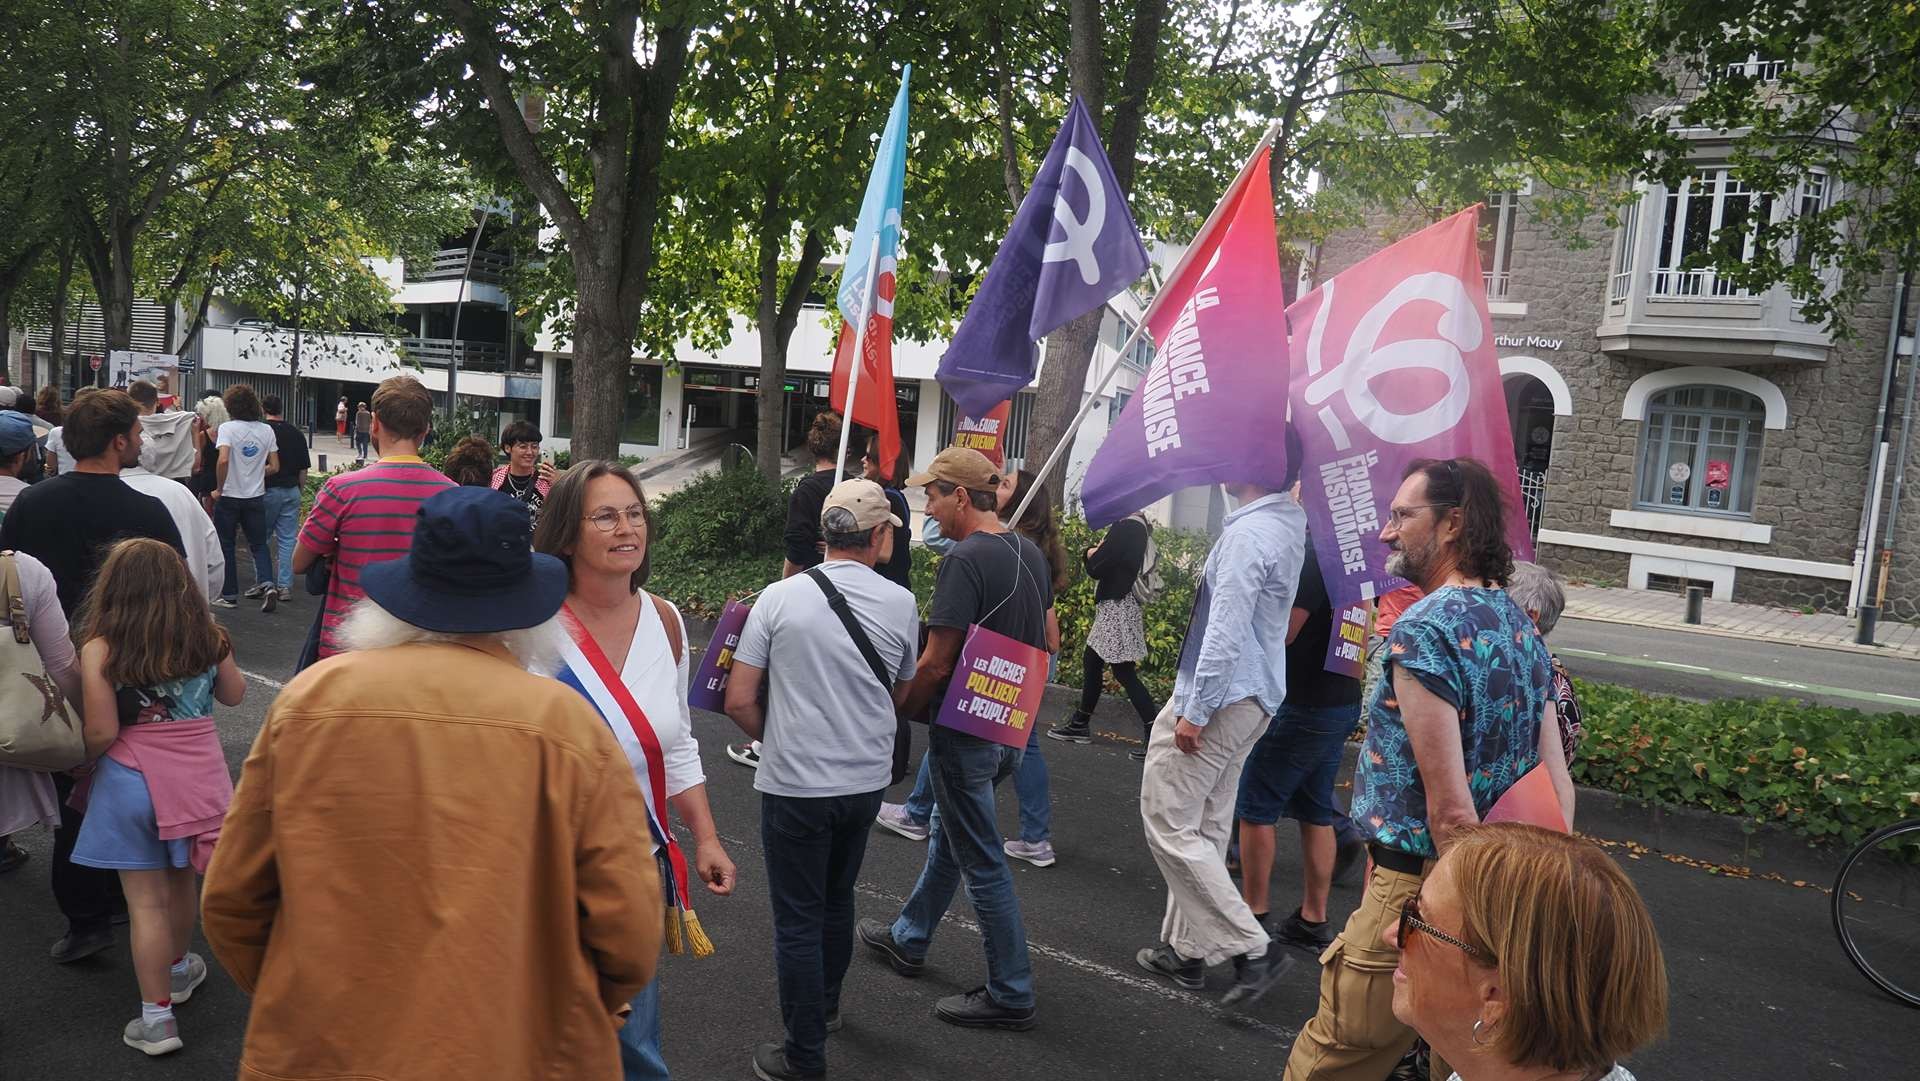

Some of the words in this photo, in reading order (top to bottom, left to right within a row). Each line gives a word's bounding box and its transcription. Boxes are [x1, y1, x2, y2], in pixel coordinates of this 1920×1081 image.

[1194, 286, 1220, 311] LA
[1168, 296, 1210, 401] FRANCE
[1494, 334, 1525, 347] rthur
[1526, 335, 1563, 351] Mouy
[1364, 449, 1379, 468] LA
[1335, 454, 1380, 535] FRANCE
[1319, 461, 1367, 576] INSOUMISE
[706, 677, 719, 690] LE
[973, 656, 989, 672] LES
[987, 655, 1027, 684] RICHES
[965, 671, 1022, 707] POLLUENT,
[957, 698, 969, 712] LE
[968, 695, 1011, 725] PEUPLE
[1007, 708, 1029, 730] PAIE
